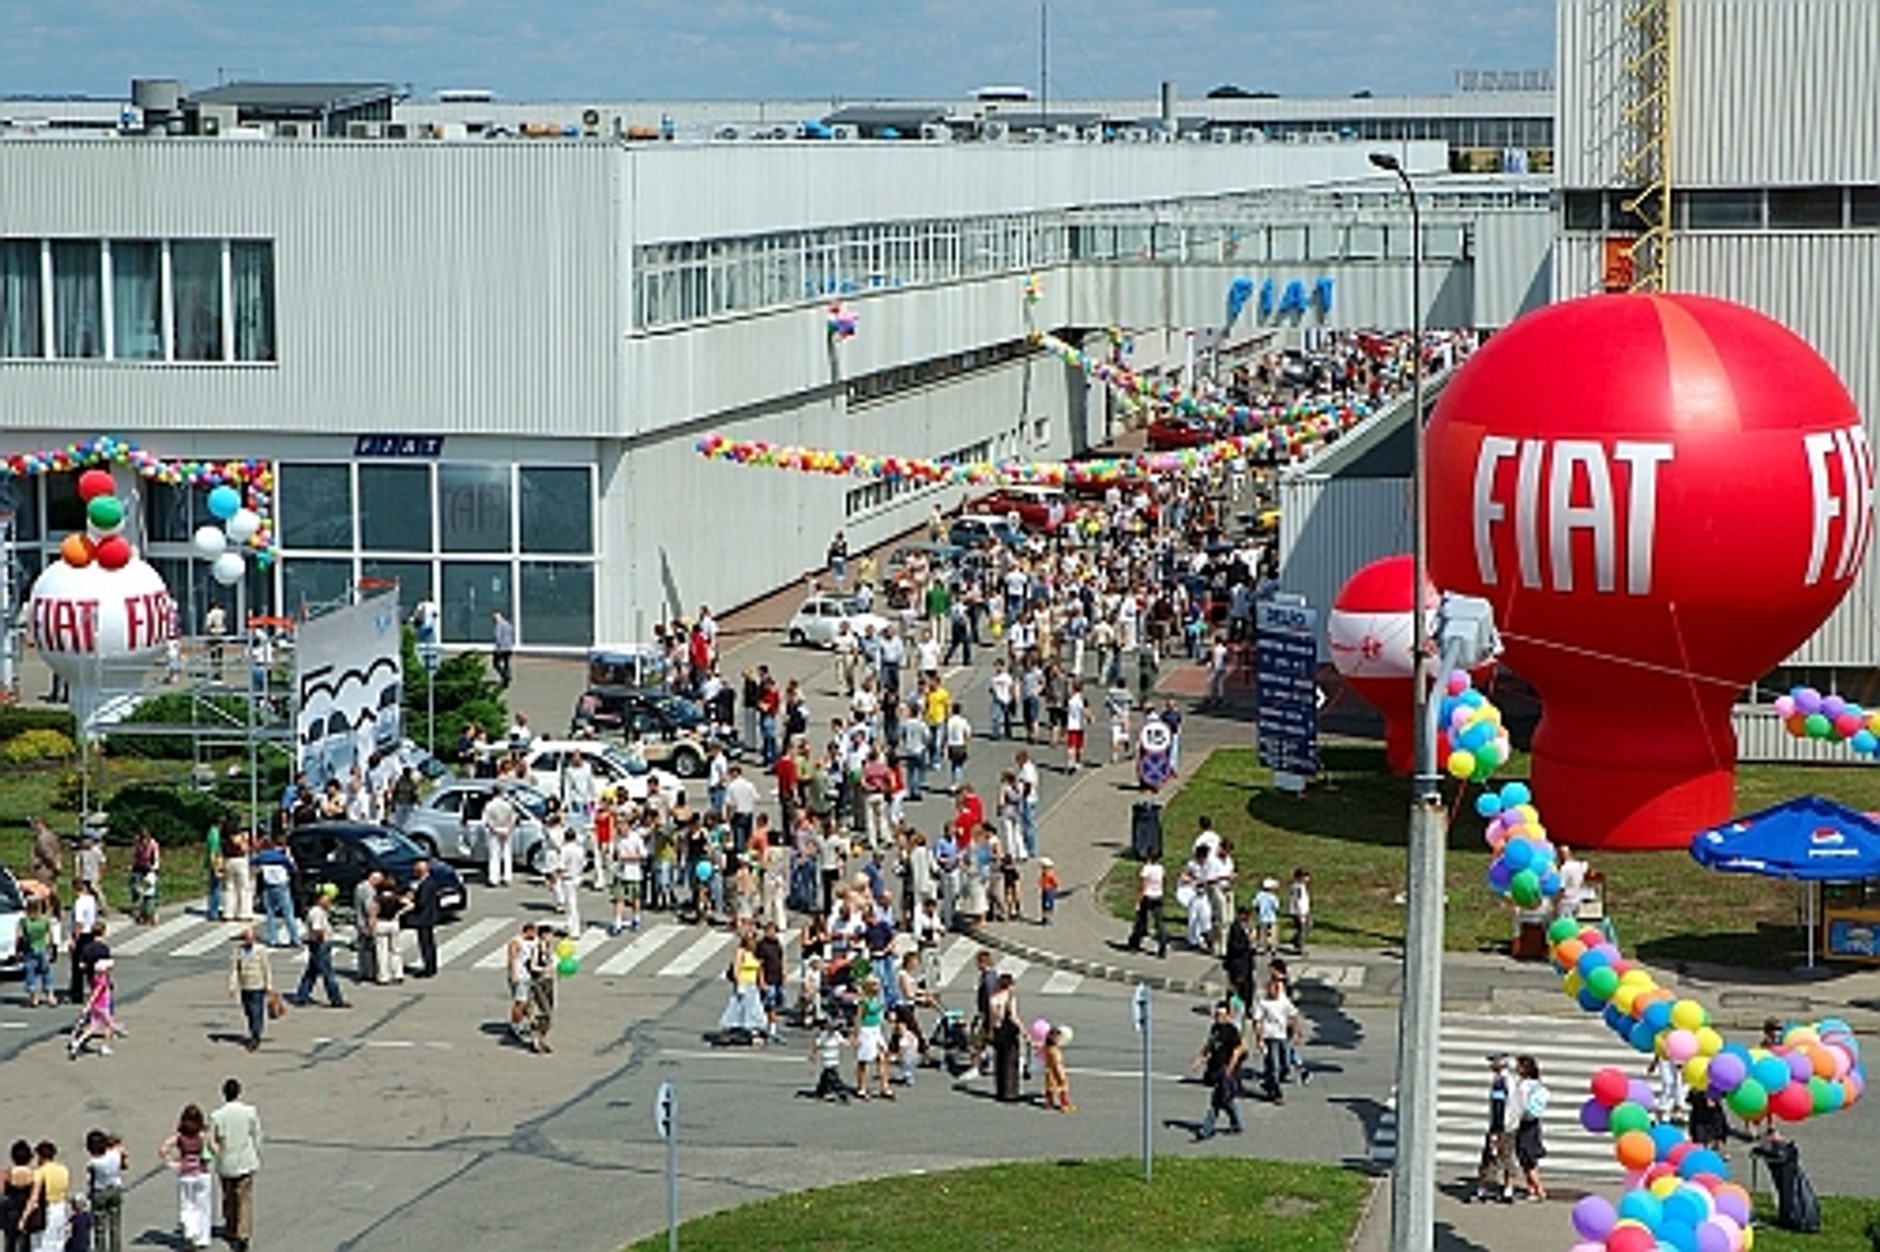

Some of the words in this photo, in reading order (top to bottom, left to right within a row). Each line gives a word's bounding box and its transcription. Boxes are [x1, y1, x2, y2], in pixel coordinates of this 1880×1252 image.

[1229, 277, 1334, 316] FIAT
[1474, 436, 1674, 595] FIAT
[1804, 425, 1873, 586] FIA
[34, 598, 99, 654] FIAT
[125, 591, 172, 650] FIA
